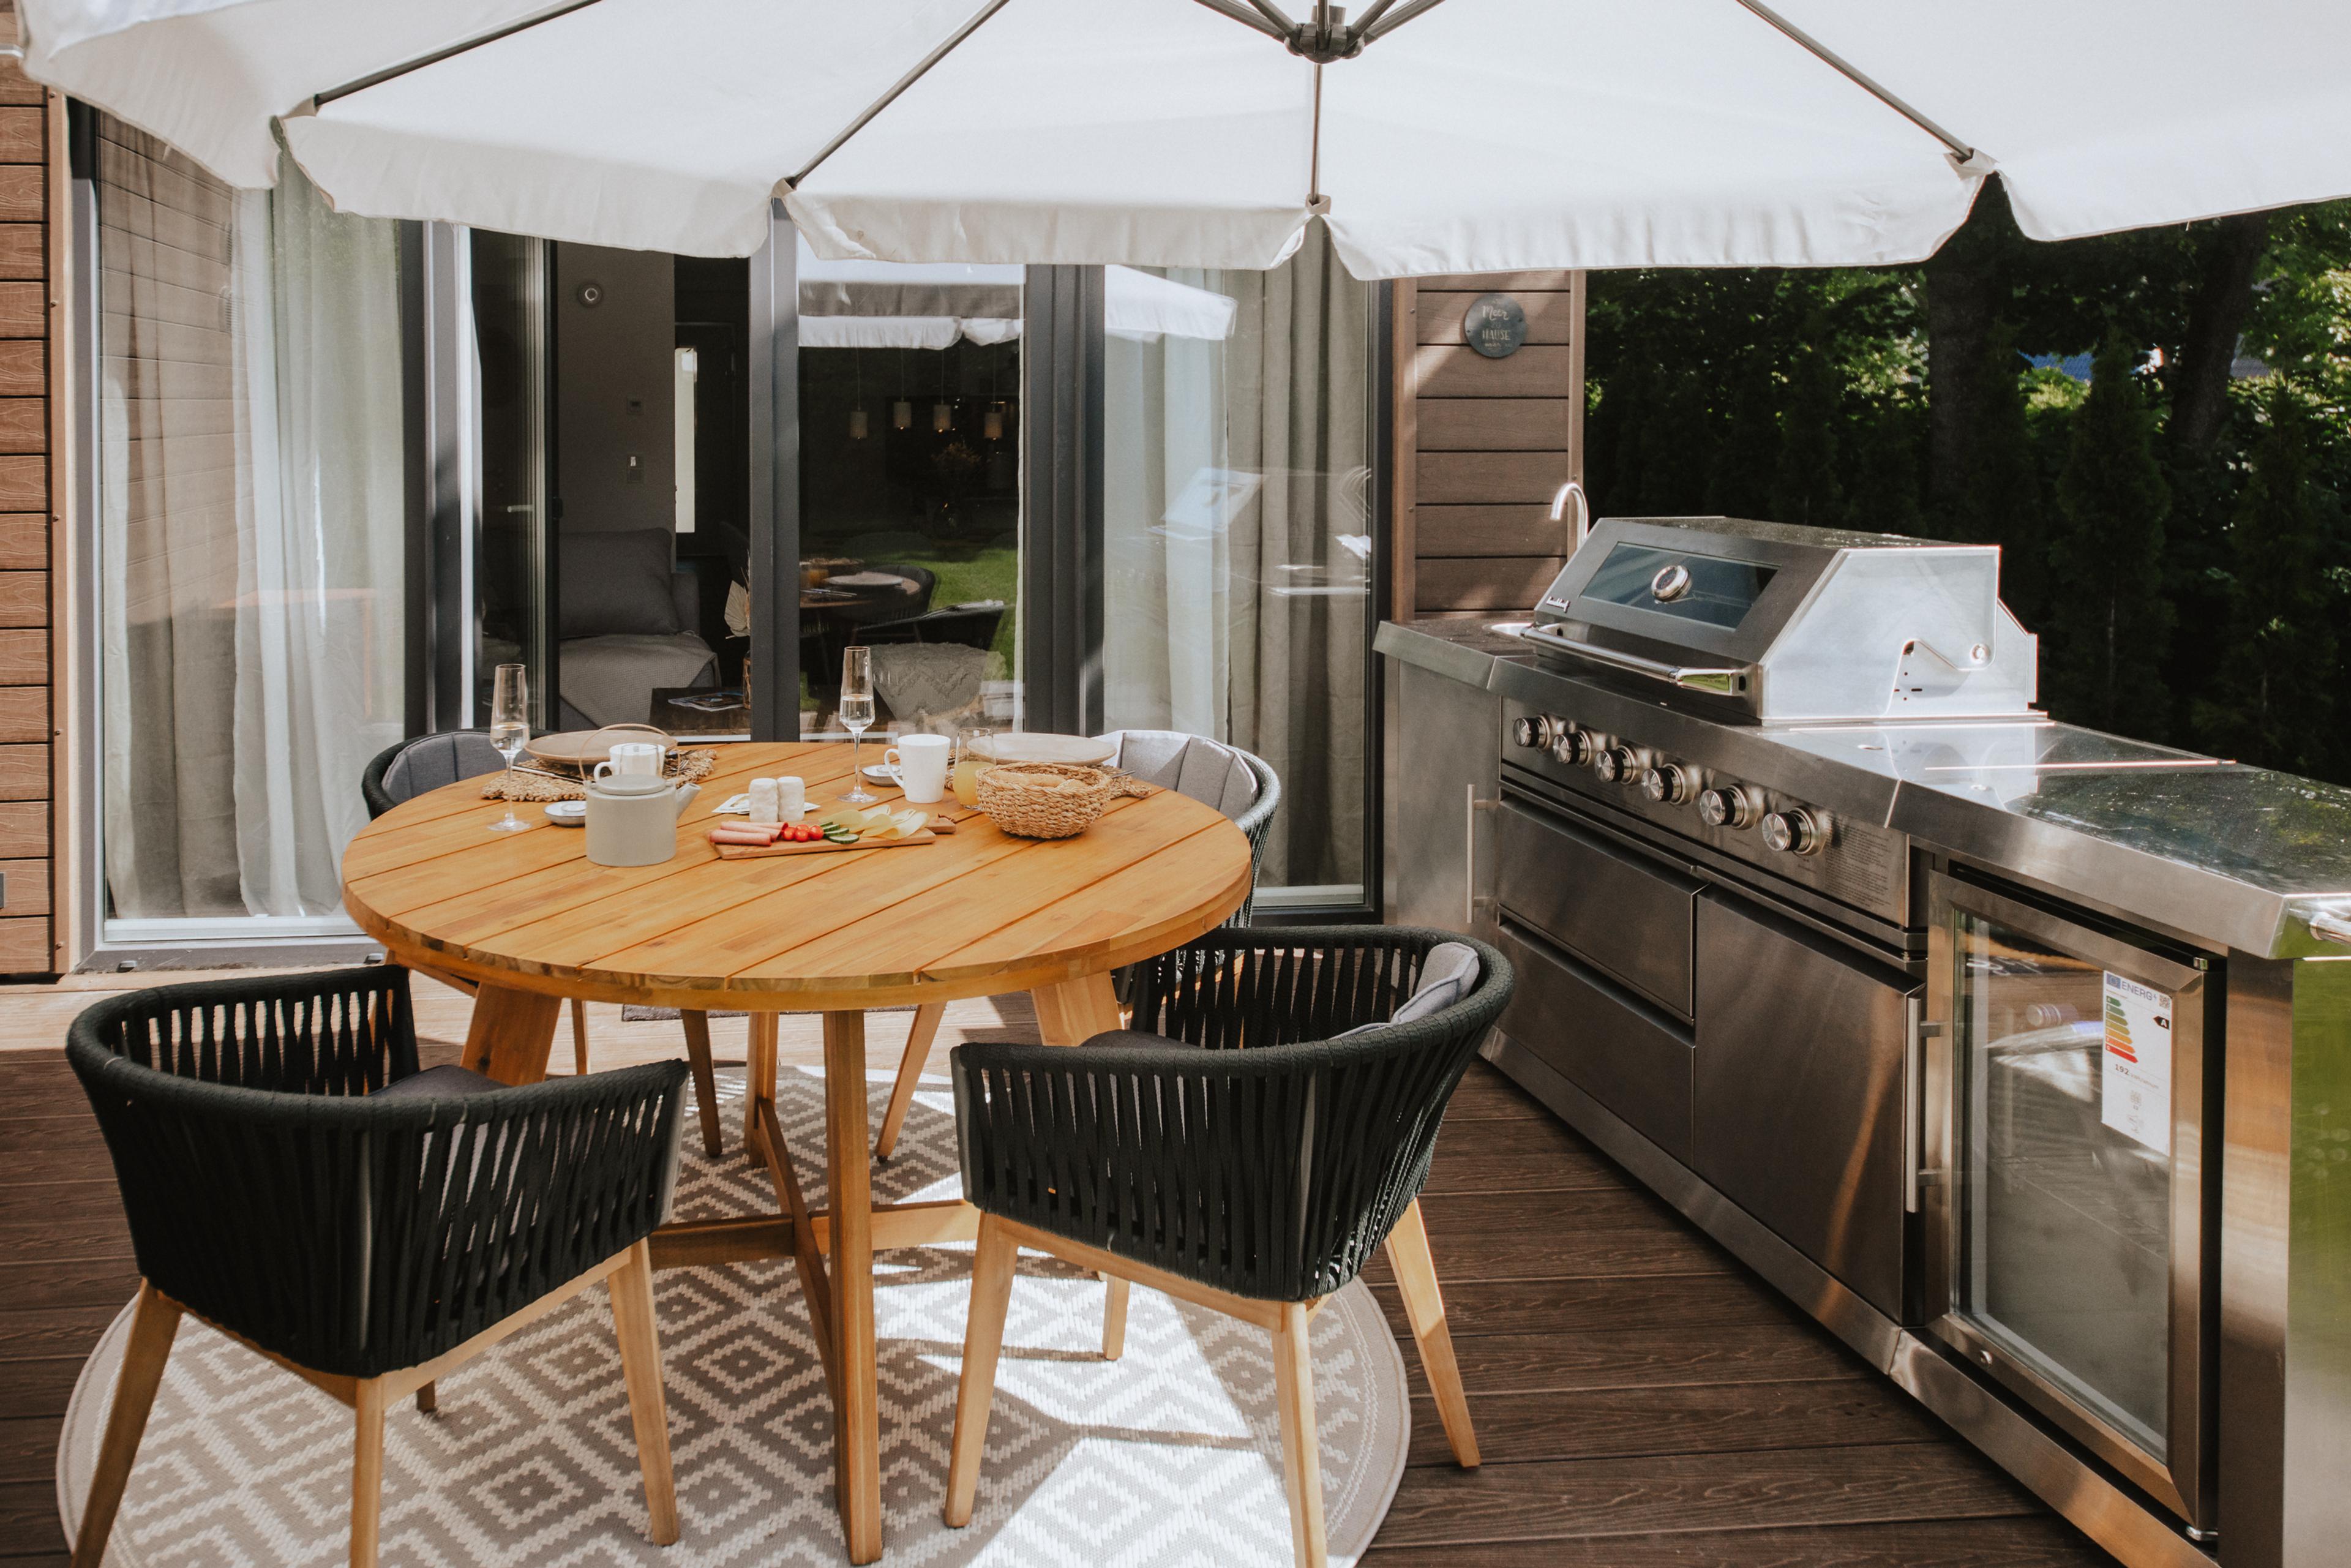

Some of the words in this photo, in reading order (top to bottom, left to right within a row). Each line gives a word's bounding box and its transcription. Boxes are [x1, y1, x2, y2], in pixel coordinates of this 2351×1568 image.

[1482, 306, 1509, 321] Meer
[2121, 981, 2153, 1000] ENERG
[2115, 1064, 2129, 1075] 192
